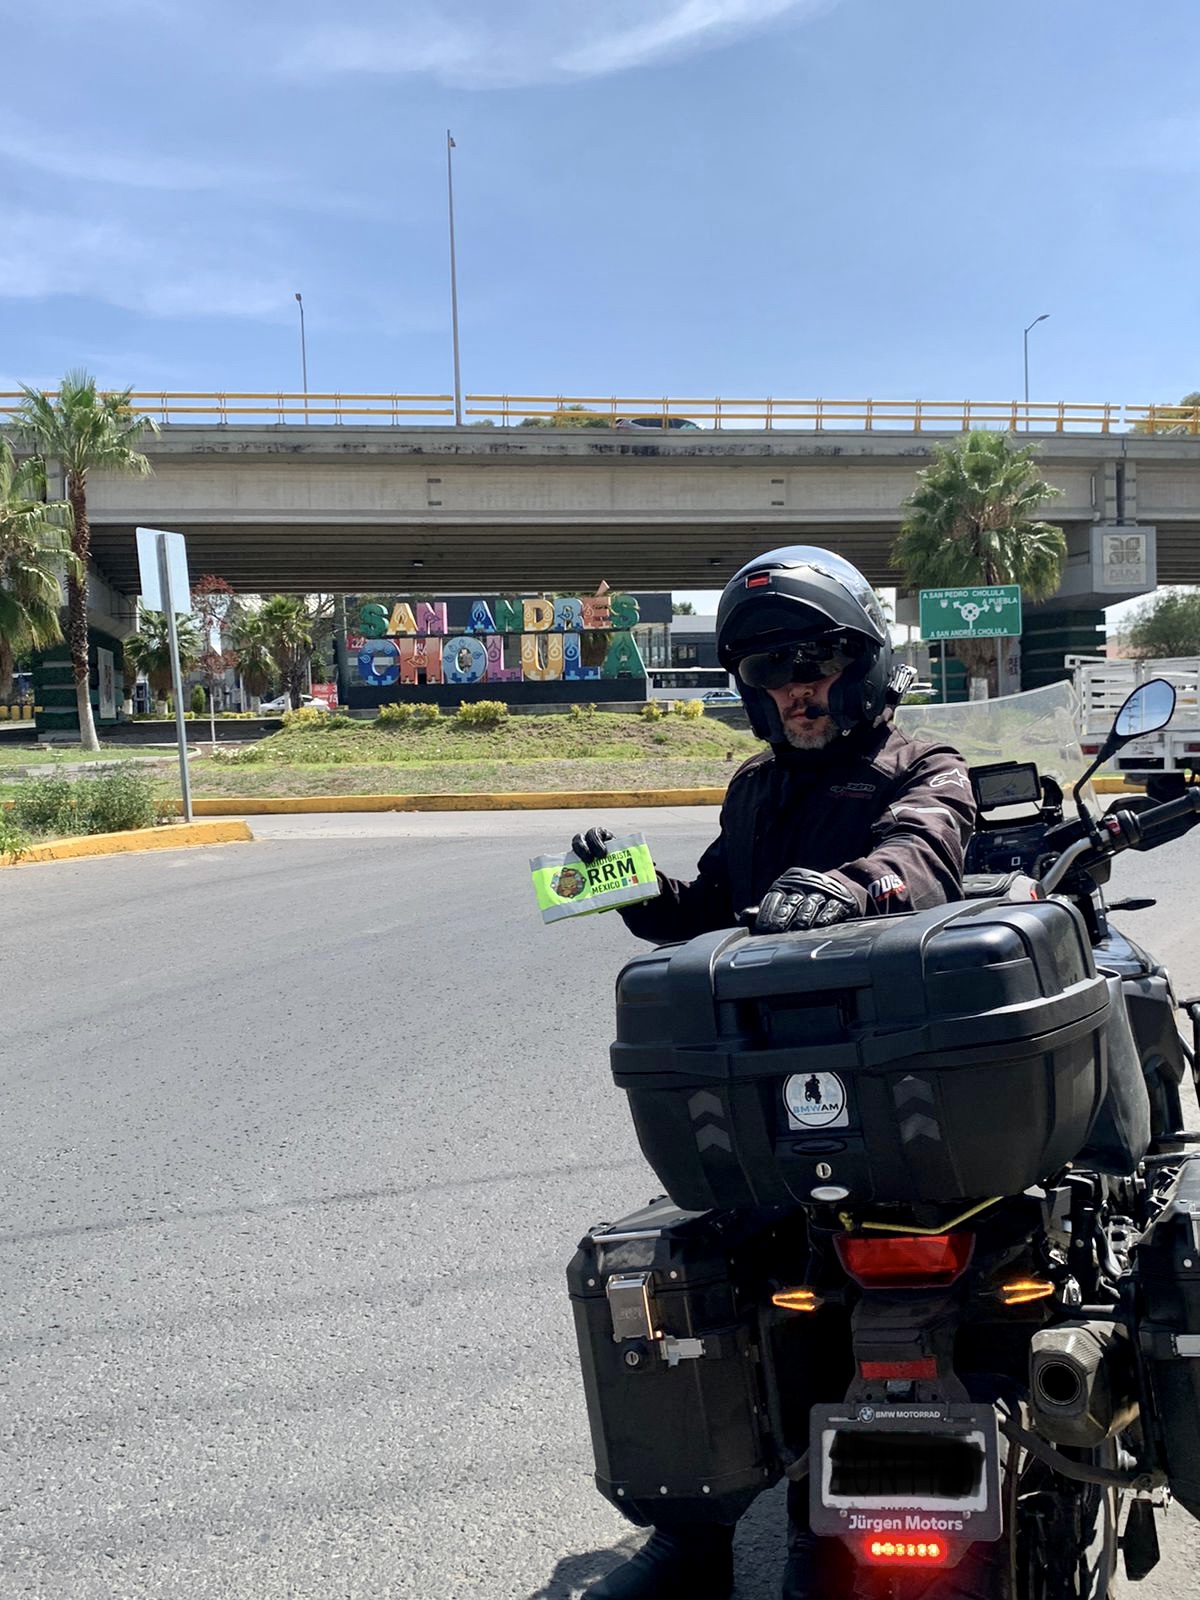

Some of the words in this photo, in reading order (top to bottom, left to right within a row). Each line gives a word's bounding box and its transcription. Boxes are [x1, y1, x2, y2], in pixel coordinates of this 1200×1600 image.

[945, 590, 969, 598] PEDRO
[972, 589, 1005, 597] CHOLULA
[360, 602, 448, 636] SAN
[358, 633, 648, 686] CHOLULA
[587, 858, 636, 886] RRM
[793, 1103, 839, 1113] BMWAM
[875, 1411, 895, 1419] BMW
[896, 1410, 941, 1419] MOTORRAD
[848, 1515, 903, 1533] Jürgen
[905, 1515, 963, 1530] Motors
